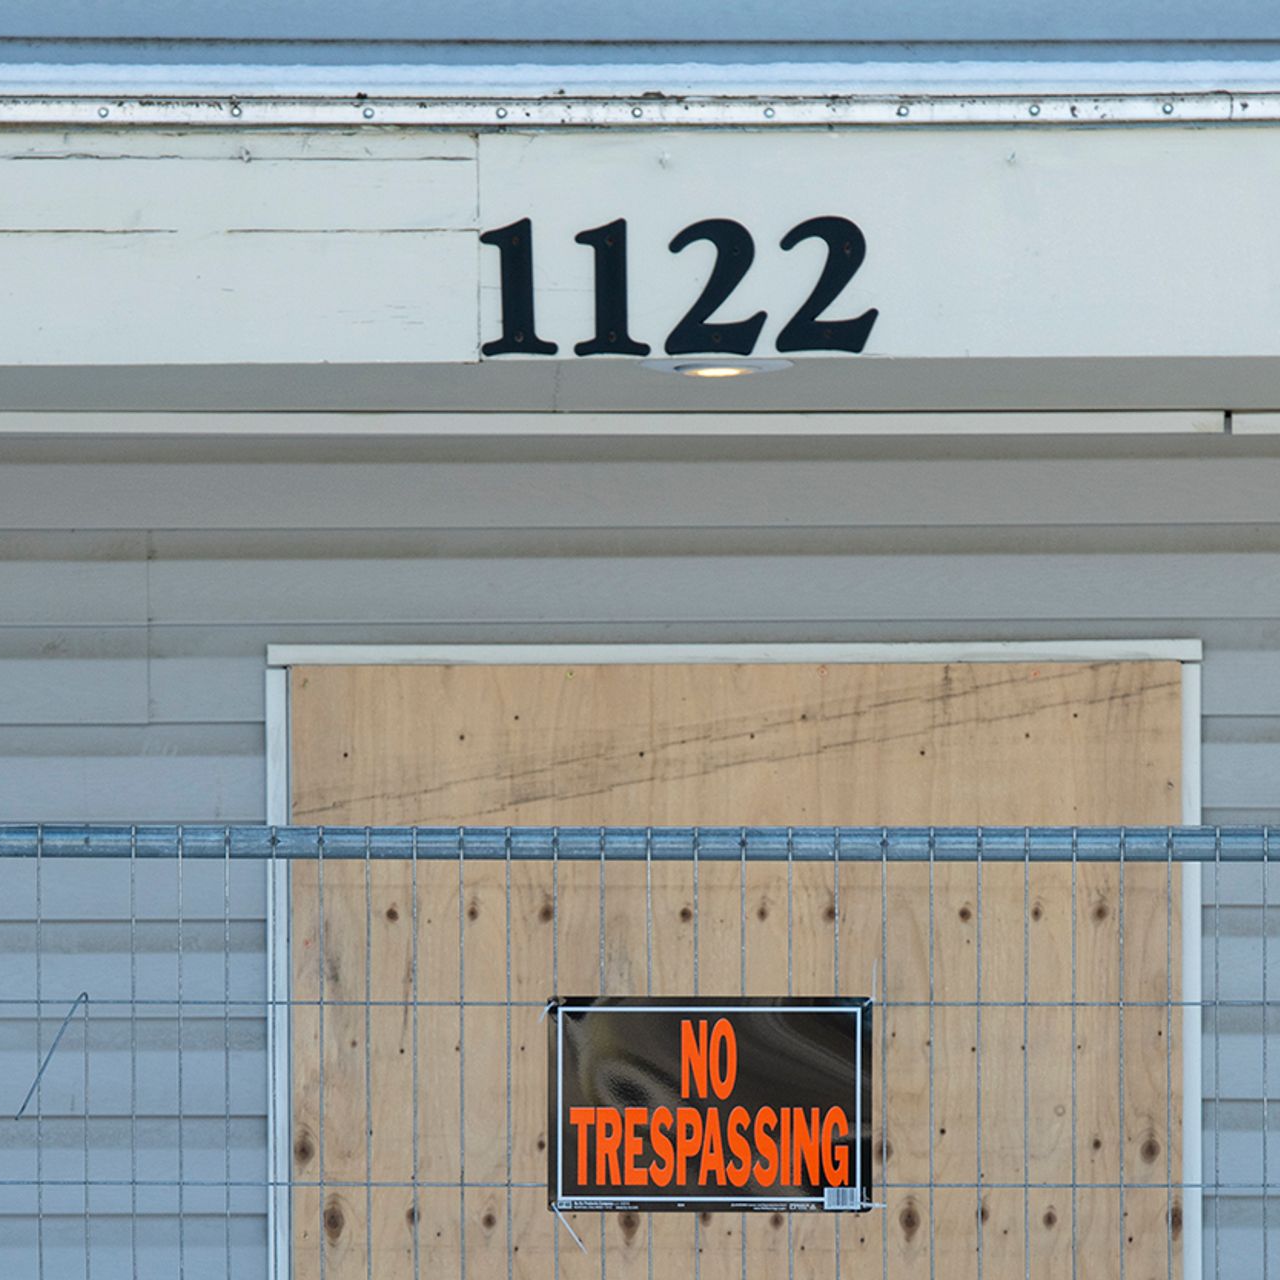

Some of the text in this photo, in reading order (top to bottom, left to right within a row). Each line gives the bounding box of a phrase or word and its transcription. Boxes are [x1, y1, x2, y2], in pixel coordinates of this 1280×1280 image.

[479, 216, 879, 357] 1122
[681, 1017, 738, 1101] NO
[569, 1106, 849, 1188] TRESPASSING
